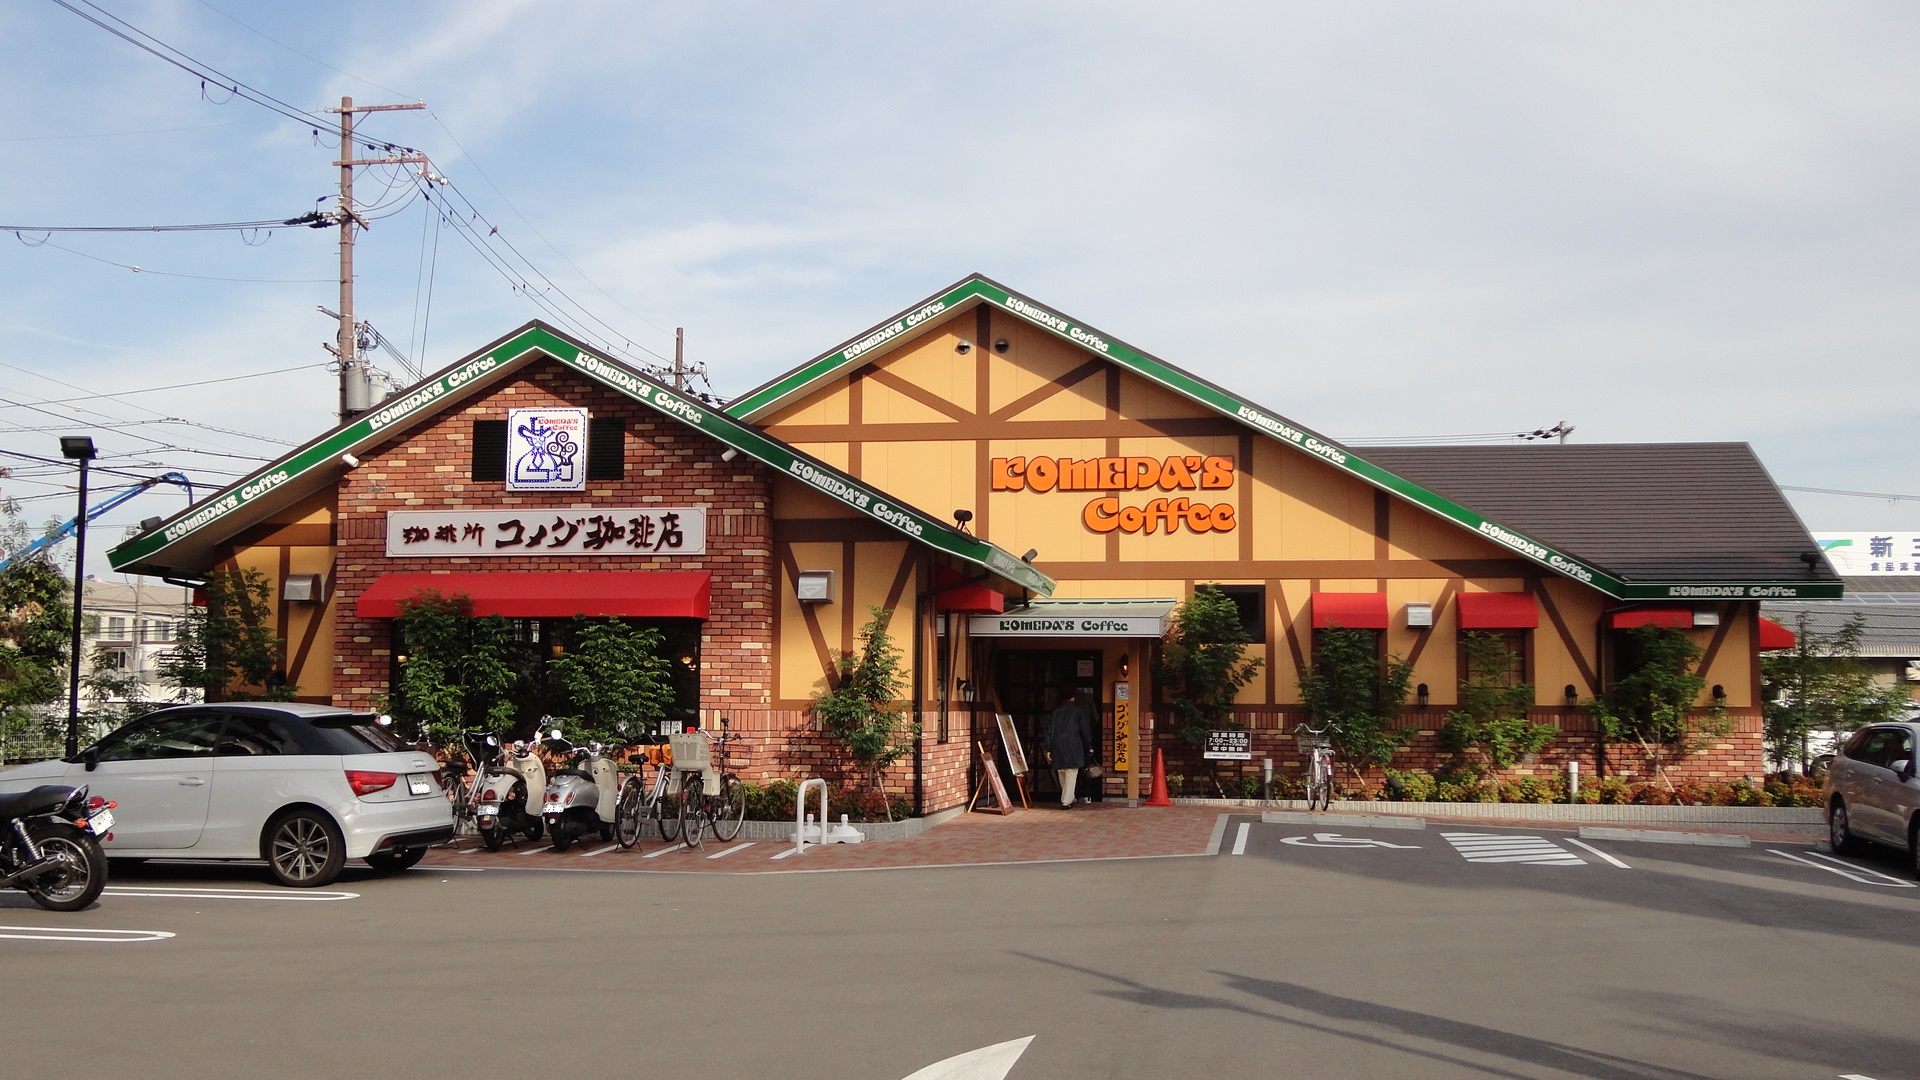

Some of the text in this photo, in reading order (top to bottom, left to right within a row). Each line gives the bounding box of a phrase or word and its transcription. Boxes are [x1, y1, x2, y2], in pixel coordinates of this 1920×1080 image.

[843, 301, 945, 360] KOMEDA'S Coffee
[1005, 296, 1109, 352] KOMEDA'S Coffee
[369, 356, 496, 430] KOMEDA'S Coffee
[574, 351, 703, 423] KOMEDA'S Coffee
[1237, 406, 1346, 463] KOMEDA'S Coffee
[789, 460, 923, 536] KOMEDA'S Coffee
[991, 456, 1234, 492] KOMEDA'S
[164, 470, 288, 541] KOMEDA'S Coffee
[495, 511, 683, 551] コメダ珈琲店
[1084, 497, 1236, 533] Coffee
[1479, 521, 1593, 582] KOMEDA'S Coffee
[1669, 586, 1797, 597] KOMEDA'S Coffee
[999, 619, 1128, 631] KOMEDA'S Coffee
